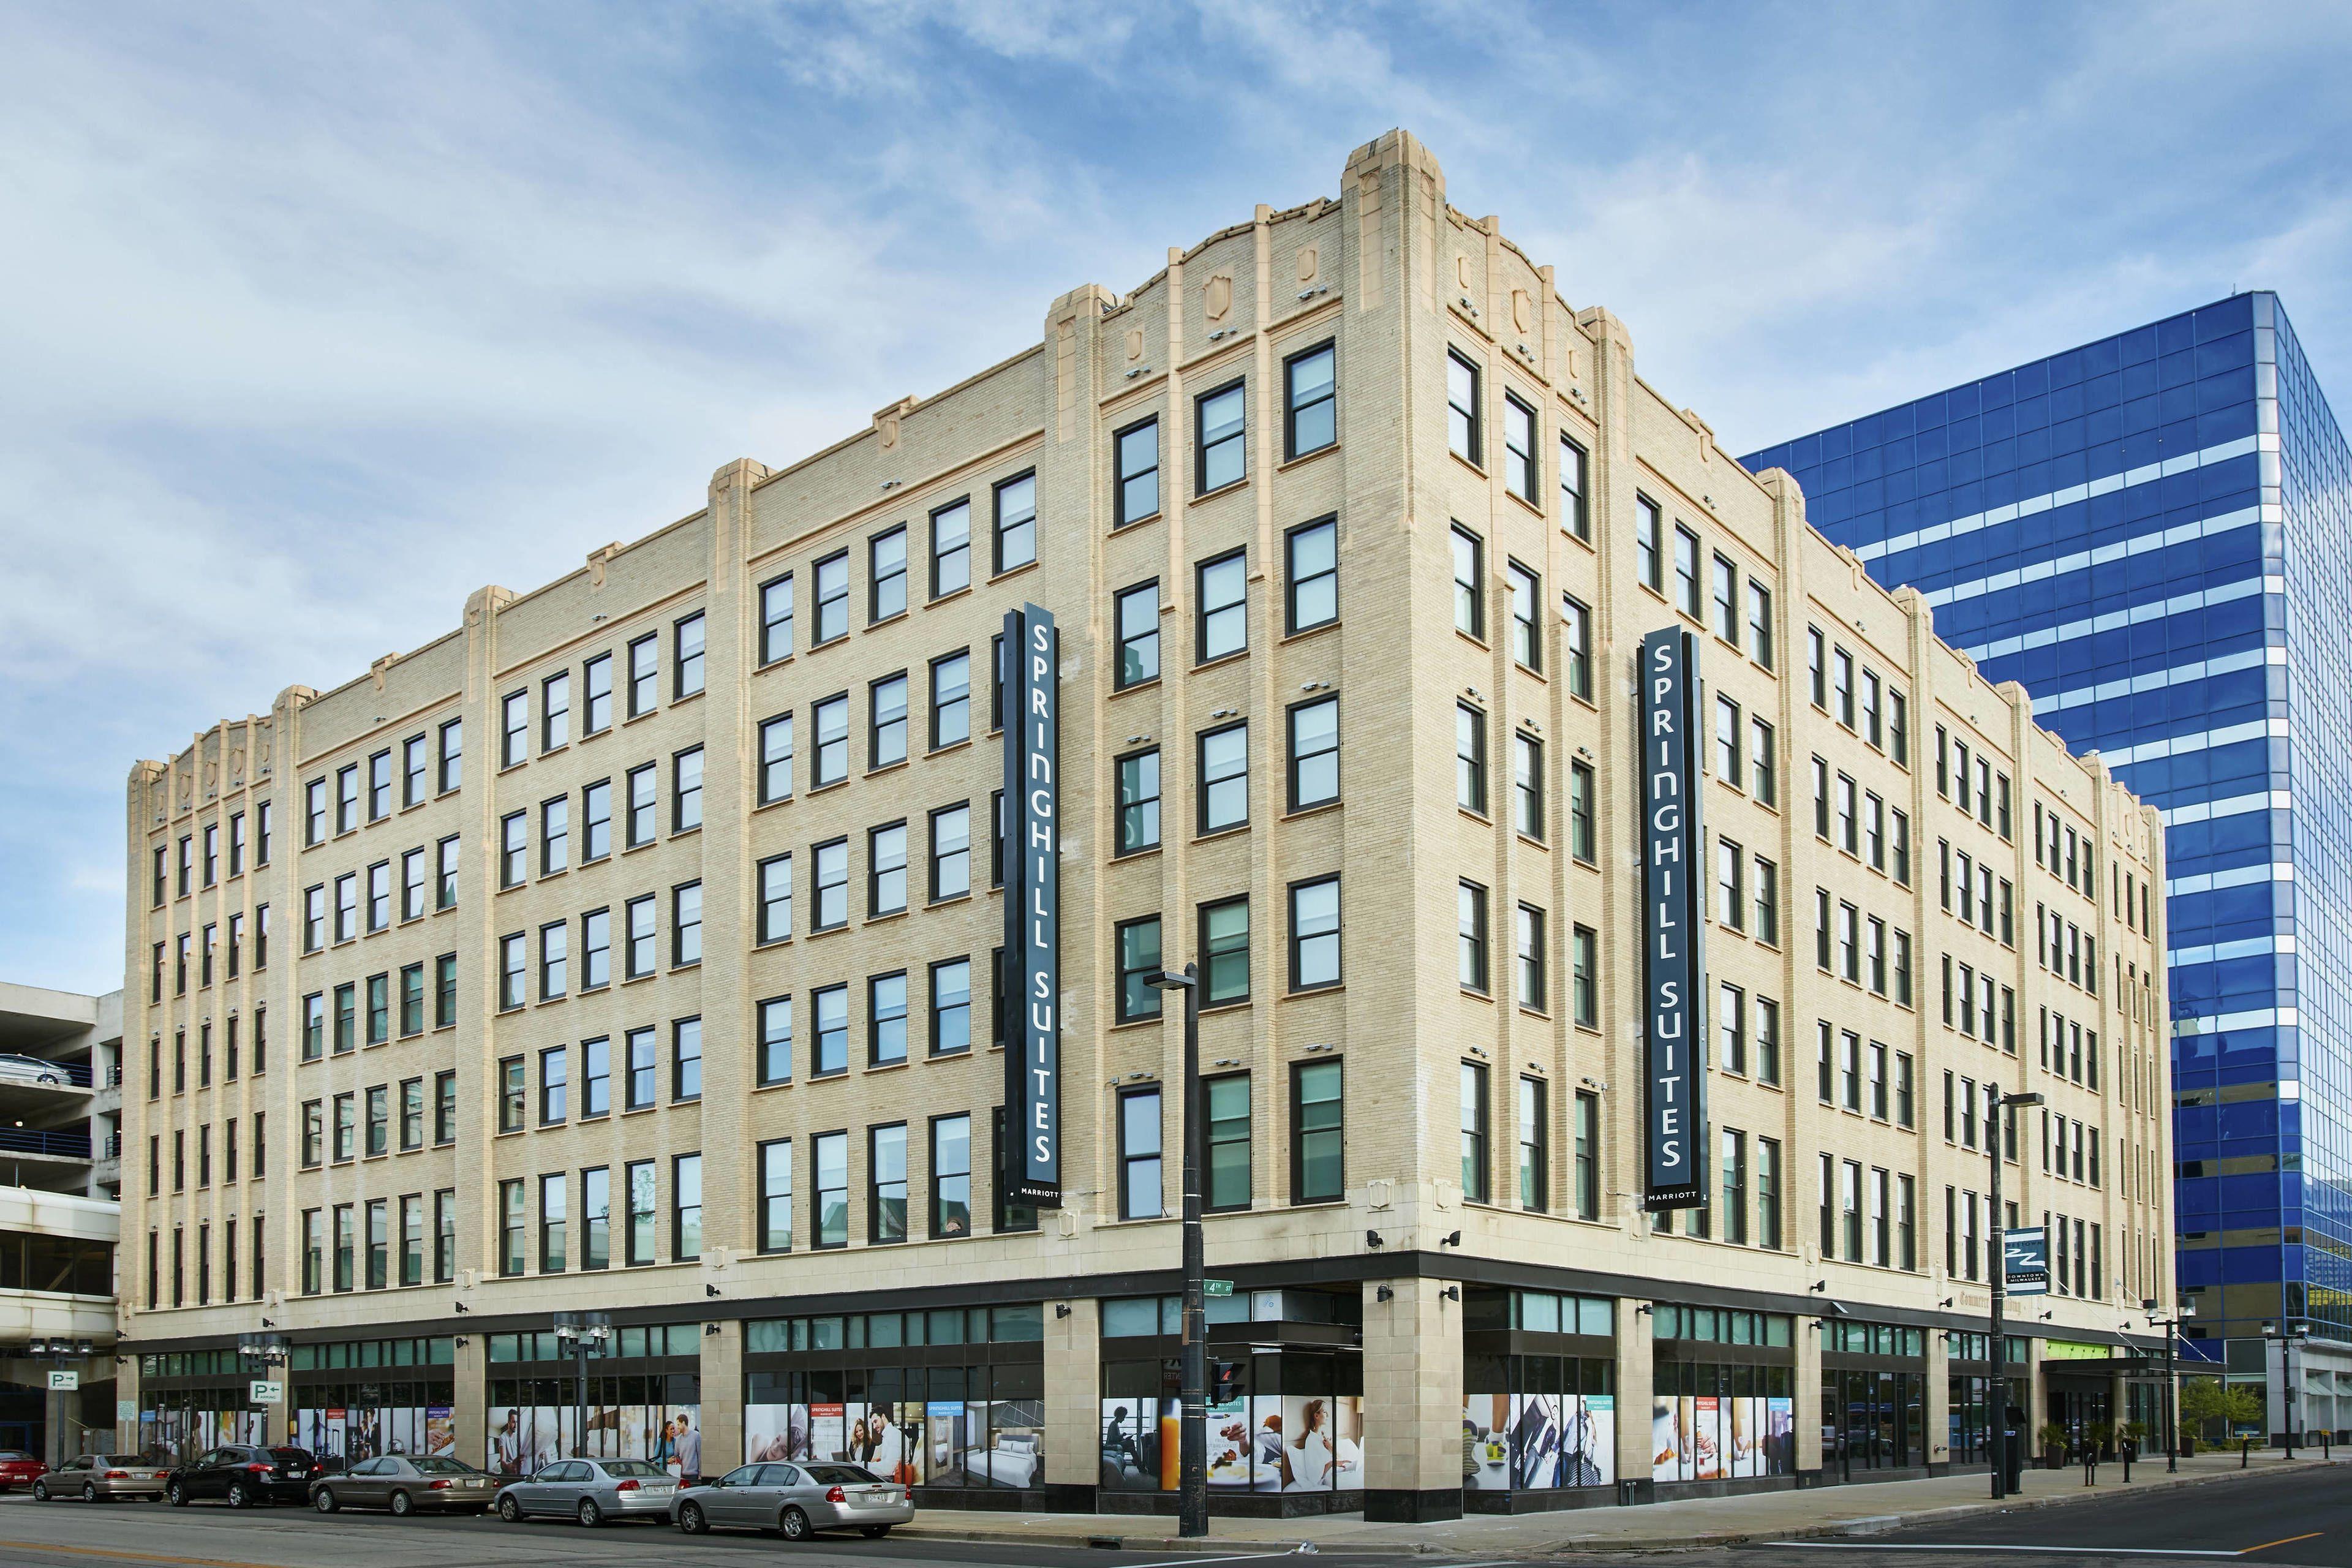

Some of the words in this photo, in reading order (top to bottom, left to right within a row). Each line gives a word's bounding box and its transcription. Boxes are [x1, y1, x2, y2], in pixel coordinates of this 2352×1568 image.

[1031, 624, 1051, 949] SPRINGHILL
[1653, 645, 1678, 959] SPRINGHILL
[1032, 971, 1052, 1163] SUITES
[1657, 981, 1681, 1167] SUITES
[1021, 1188, 1059, 1198] MARRIOTT
[1648, 1191, 1697, 1201] MARRIOTT
[1209, 1283, 1221, 1292] 4TH
